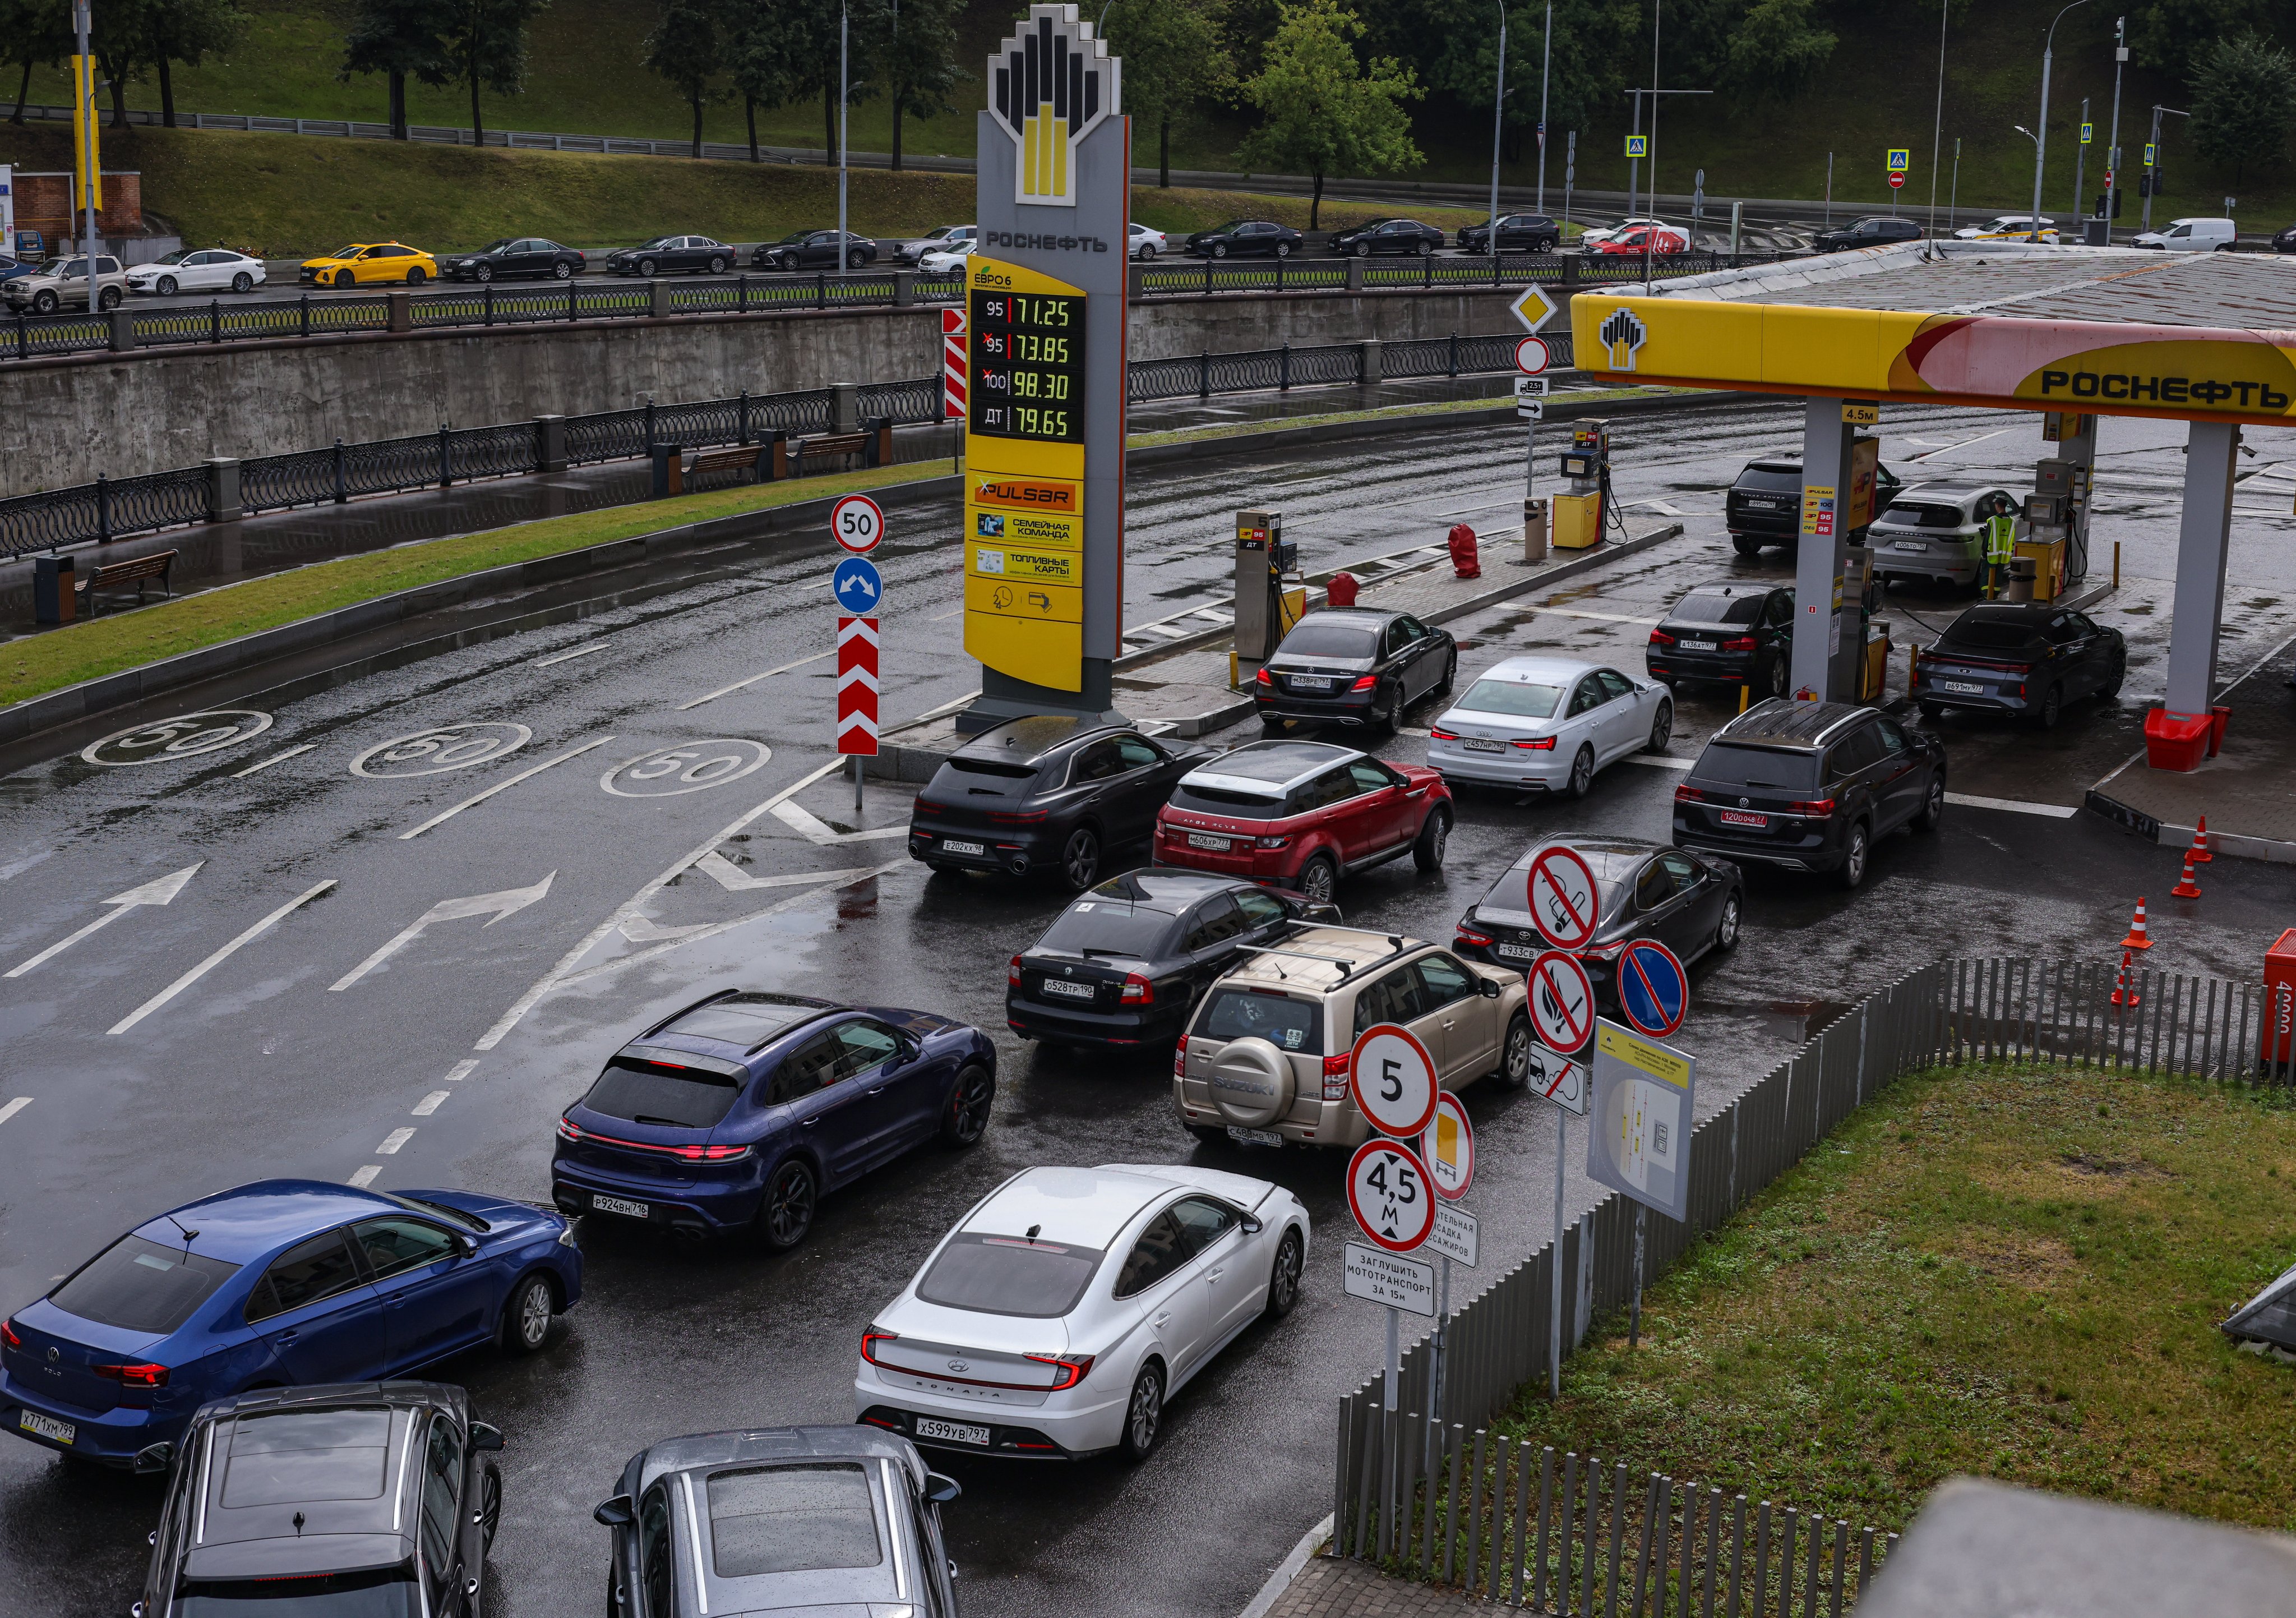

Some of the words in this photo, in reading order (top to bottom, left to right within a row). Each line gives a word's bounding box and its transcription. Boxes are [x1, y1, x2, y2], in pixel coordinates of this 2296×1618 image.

[986, 231, 1108, 252] РОСНЕФТЬ
[974, 274, 1003, 284] ЕВРО
[1005, 276, 1011, 285] 6
[987, 301, 1003, 316] 95
[1017, 298, 1069, 326] 71.25
[986, 338, 1003, 353] 95
[1017, 335, 1068, 363] 73.85
[984, 374, 1006, 389] 100
[1014, 371, 1069, 400] 98.30
[2041, 370, 2289, 408] РОСНЕФТЬ
[985, 408, 1003, 425] ДТ
[1016, 407, 1068, 436] 79.65
[1591, 424, 1600, 433] 6
[843, 512, 871, 536] 50
[1013, 519, 1070, 531] СЕМЕЙНАЯ
[1018, 527, 1069, 539] КОМАНДА
[1258, 516, 1268, 527] 5
[1010, 554, 1069, 567] ТОПЛИВНЫЕ
[1034, 565, 1069, 575] КАРТЫ
[118, 722, 239, 752] 50
[384, 735, 501, 763] 50
[630, 752, 742, 782] 50
[1213, 1076, 1274, 1095] SUZUKI
[1380, 1058, 1402, 1101] 5
[1367, 1161, 1416, 1204] 4,5
[1429, 1233, 1468, 1256] ССАЖИРОВ
[1360, 1255, 1418, 1279] ЗАГЛУШИТЬ
[1347, 1265, 1431, 1296] МОТОТРАНСПОРТ
[1373, 1285, 1384, 1296] ЗА
[44, 1367, 61, 1376] POLO
[916, 1381, 1000, 1398] SONATA
